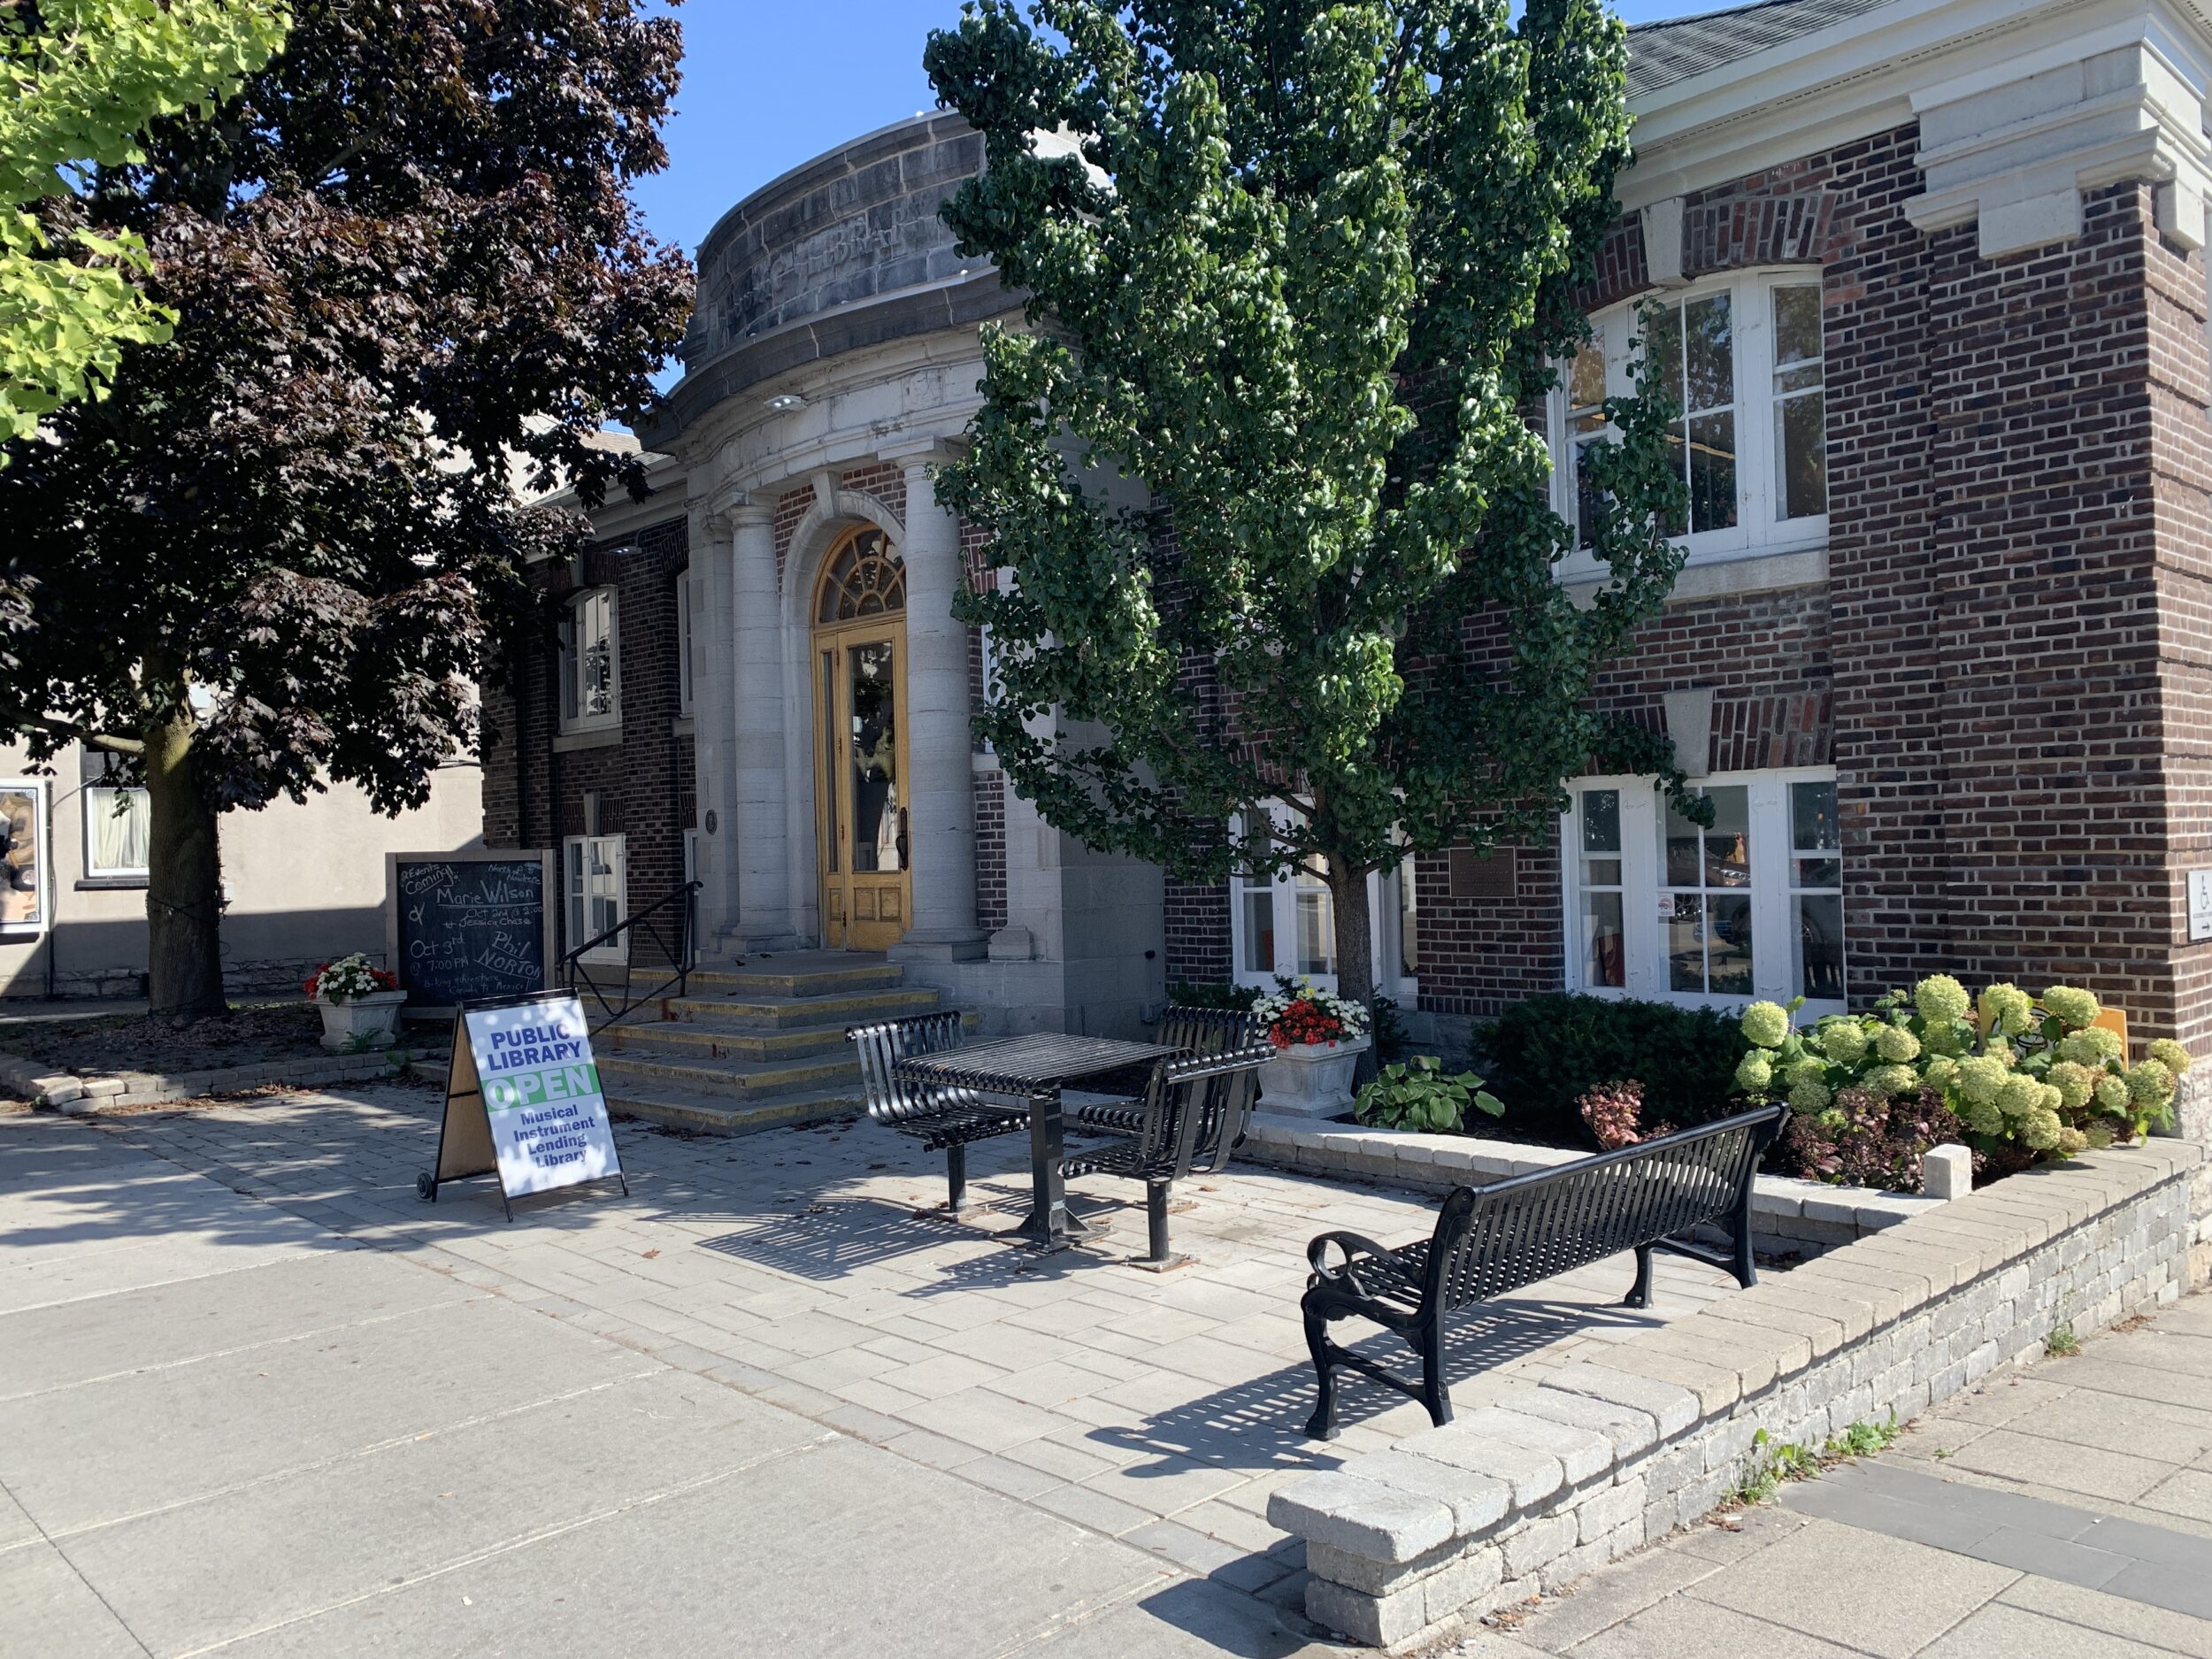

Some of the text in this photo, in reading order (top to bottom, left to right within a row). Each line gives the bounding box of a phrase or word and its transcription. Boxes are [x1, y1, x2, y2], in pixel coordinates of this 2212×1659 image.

[410, 864, 440, 878] Events
[436, 880, 534, 904] Marie Wilson
[410, 940, 439, 959] Oct
[492, 931, 531, 958] Phil
[454, 955, 469, 969] PM
[474, 948, 543, 979] NORTON
[490, 1024, 571, 1050] PUBLIC
[487, 1041, 581, 1071] LIBRARY
[485, 1064, 594, 1110] OPEN
[520, 1104, 579, 1125] Musical
[513, 1117, 595, 1142] Instrument
[526, 1133, 588, 1155] Lending
[535, 1149, 587, 1169] Library
